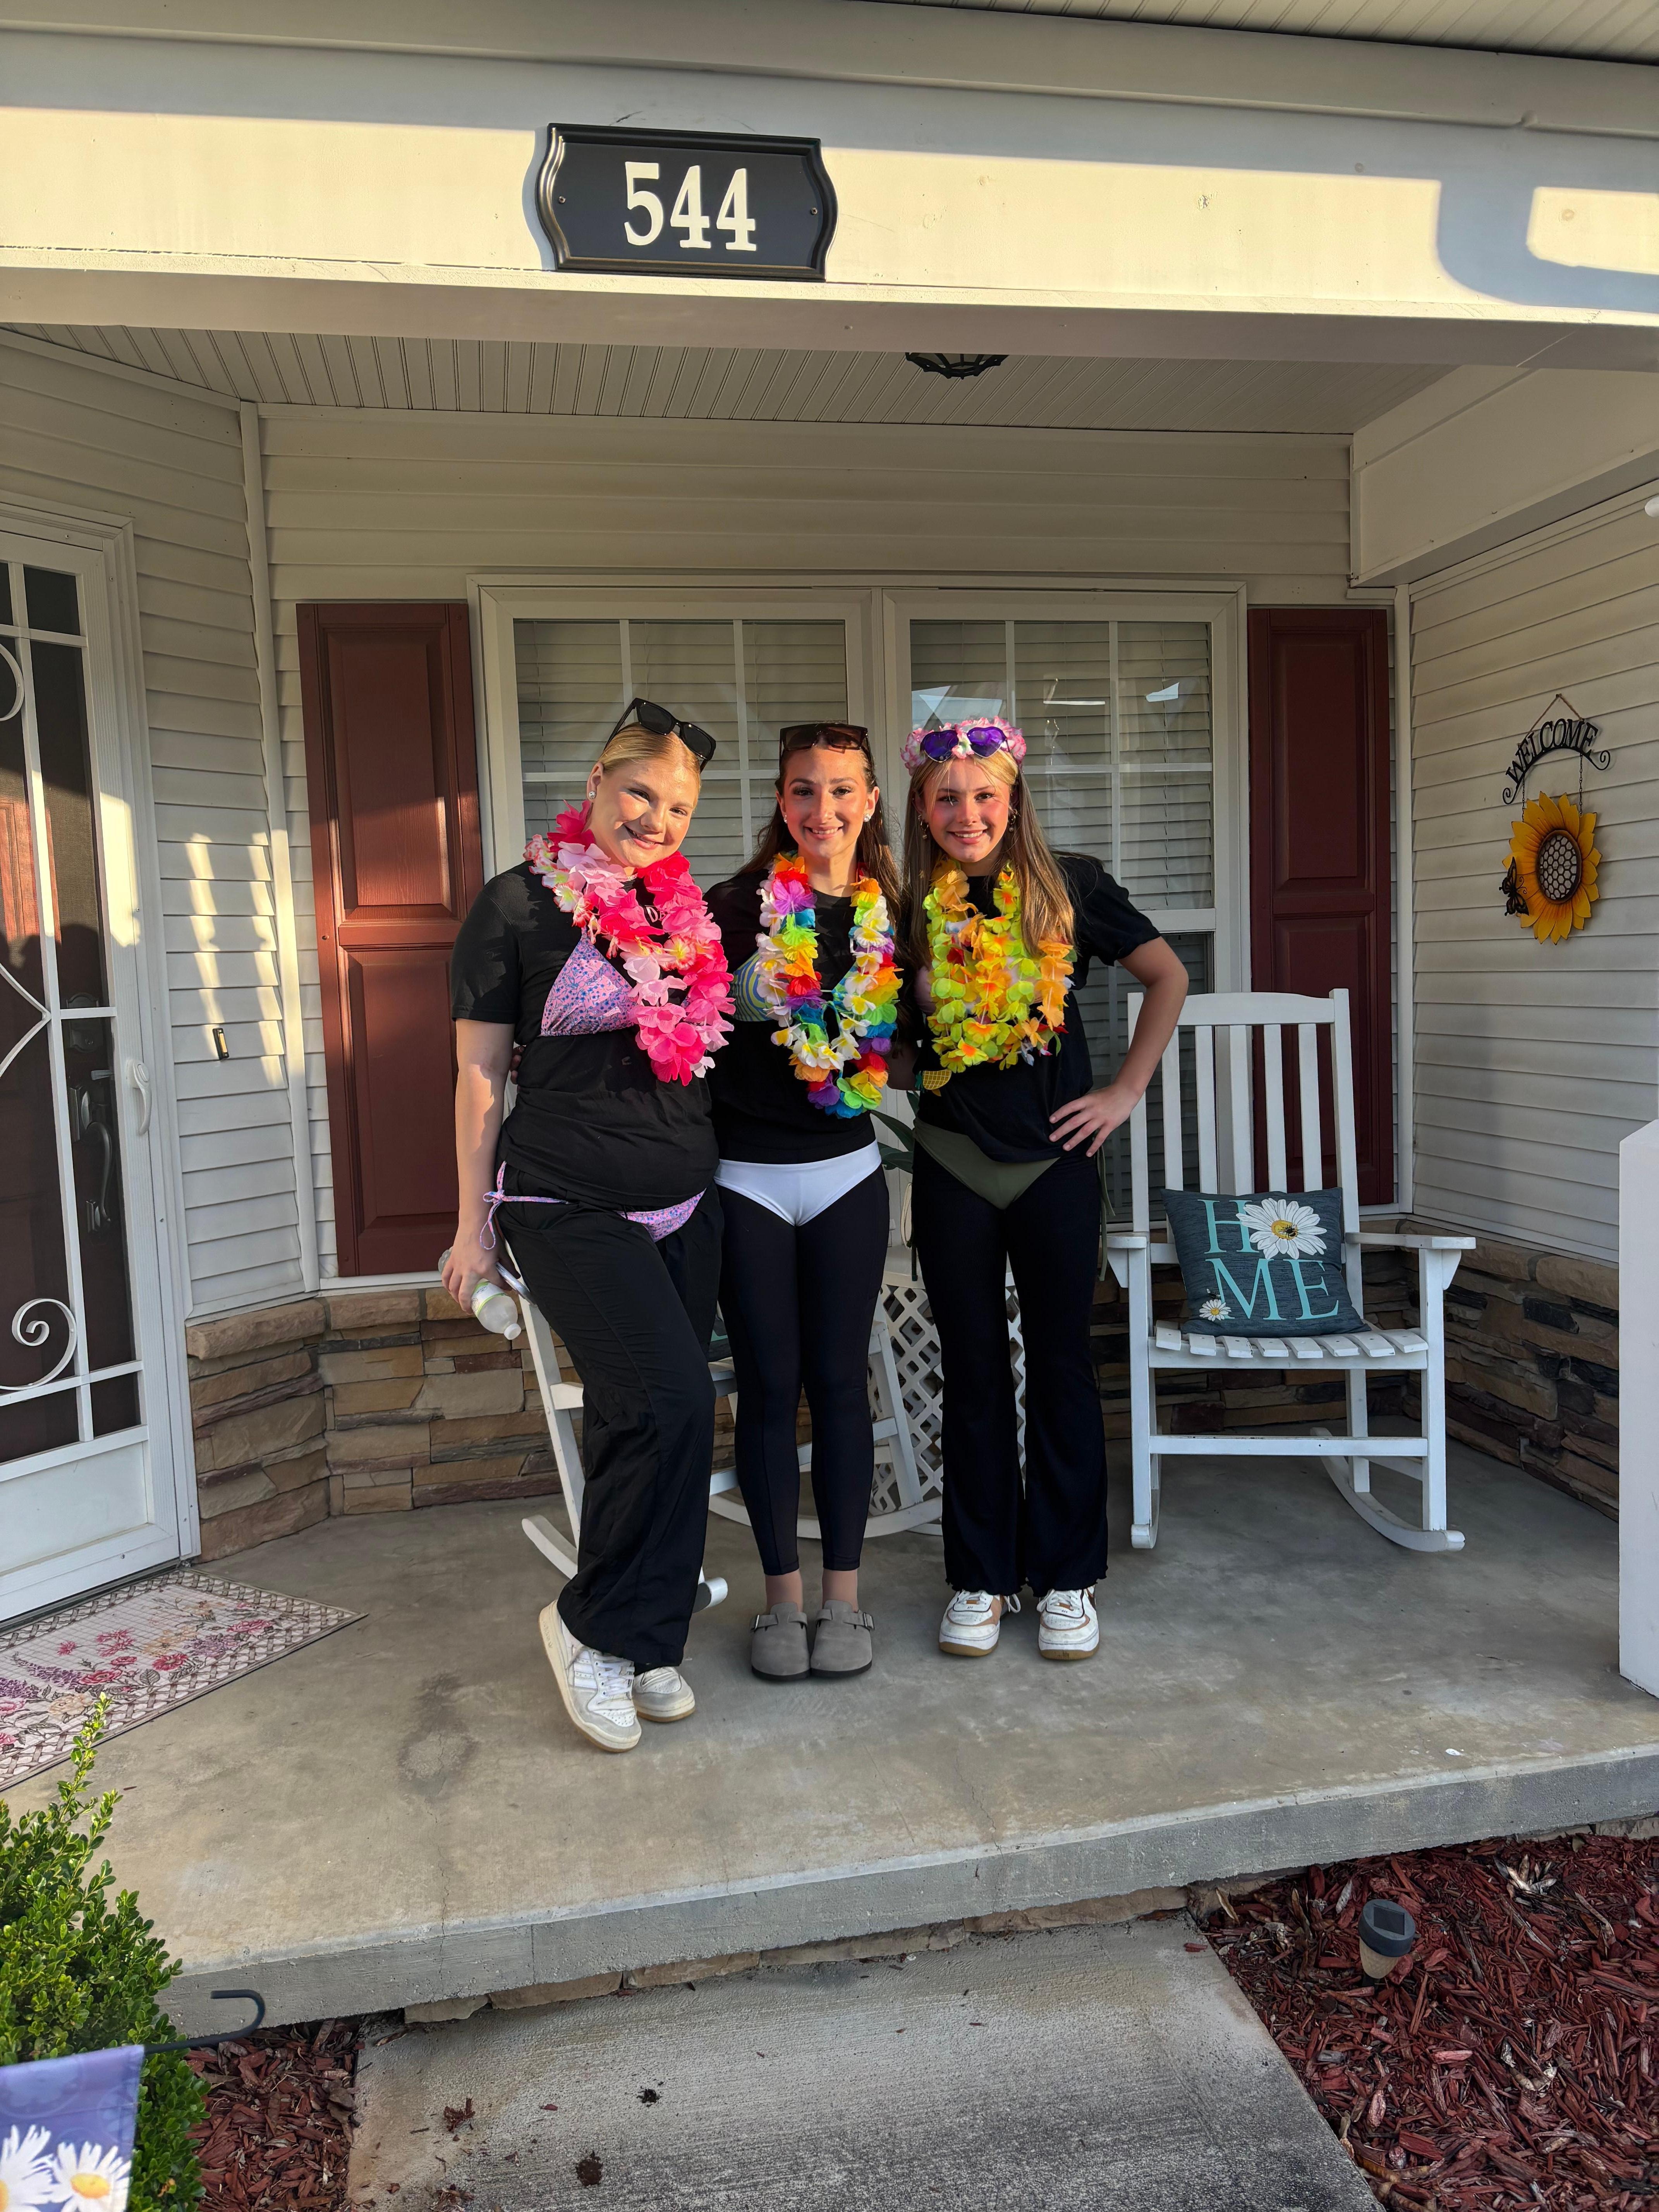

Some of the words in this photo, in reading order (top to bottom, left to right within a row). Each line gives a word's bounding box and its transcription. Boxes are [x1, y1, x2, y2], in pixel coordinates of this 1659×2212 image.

[624, 161, 757, 251] 544
[1506, 718, 1599, 785] WELCOME
[1205, 1258, 1339, 1320] ME
